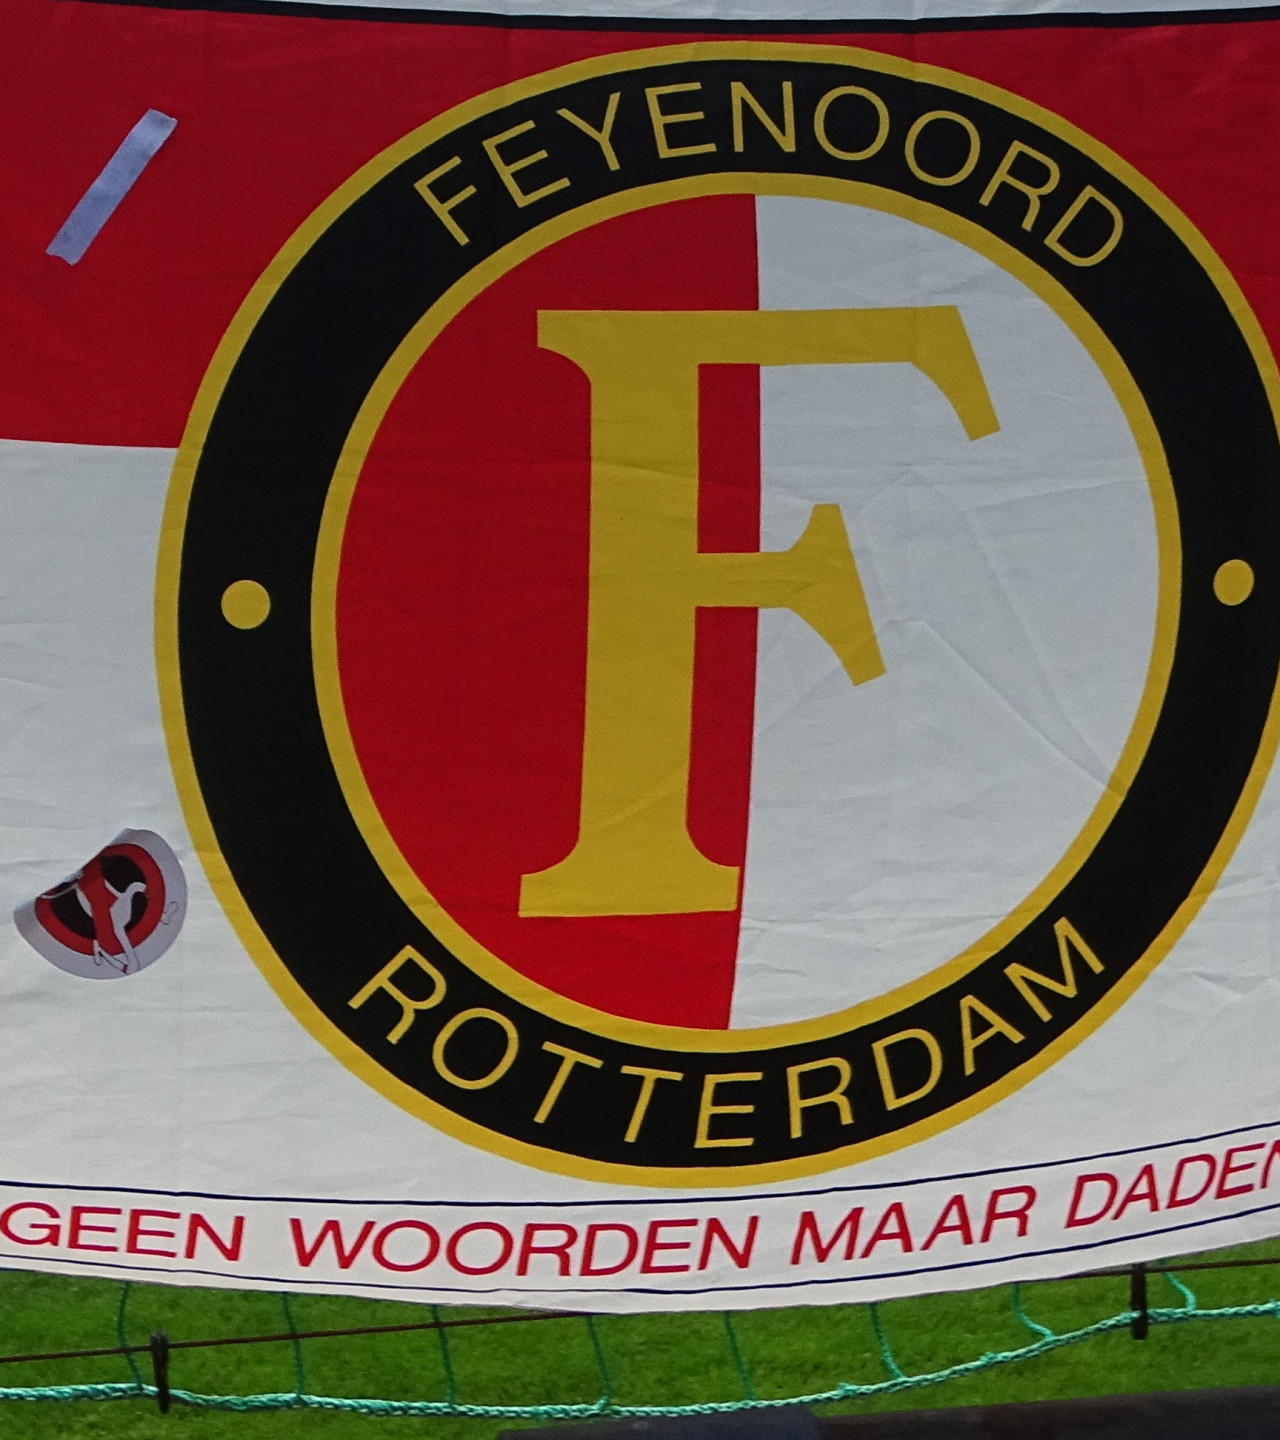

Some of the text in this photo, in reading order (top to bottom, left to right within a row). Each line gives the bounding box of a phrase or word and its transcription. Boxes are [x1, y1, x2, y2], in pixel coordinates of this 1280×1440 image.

[413, 81, 1124, 267] FEYENOORD
[519, 305, 1000, 918] F
[347, 916, 1105, 1149] ROTTERDAM
[289, 1215, 760, 1277] WOORDEN
[790, 1185, 1038, 1266] MAAR
